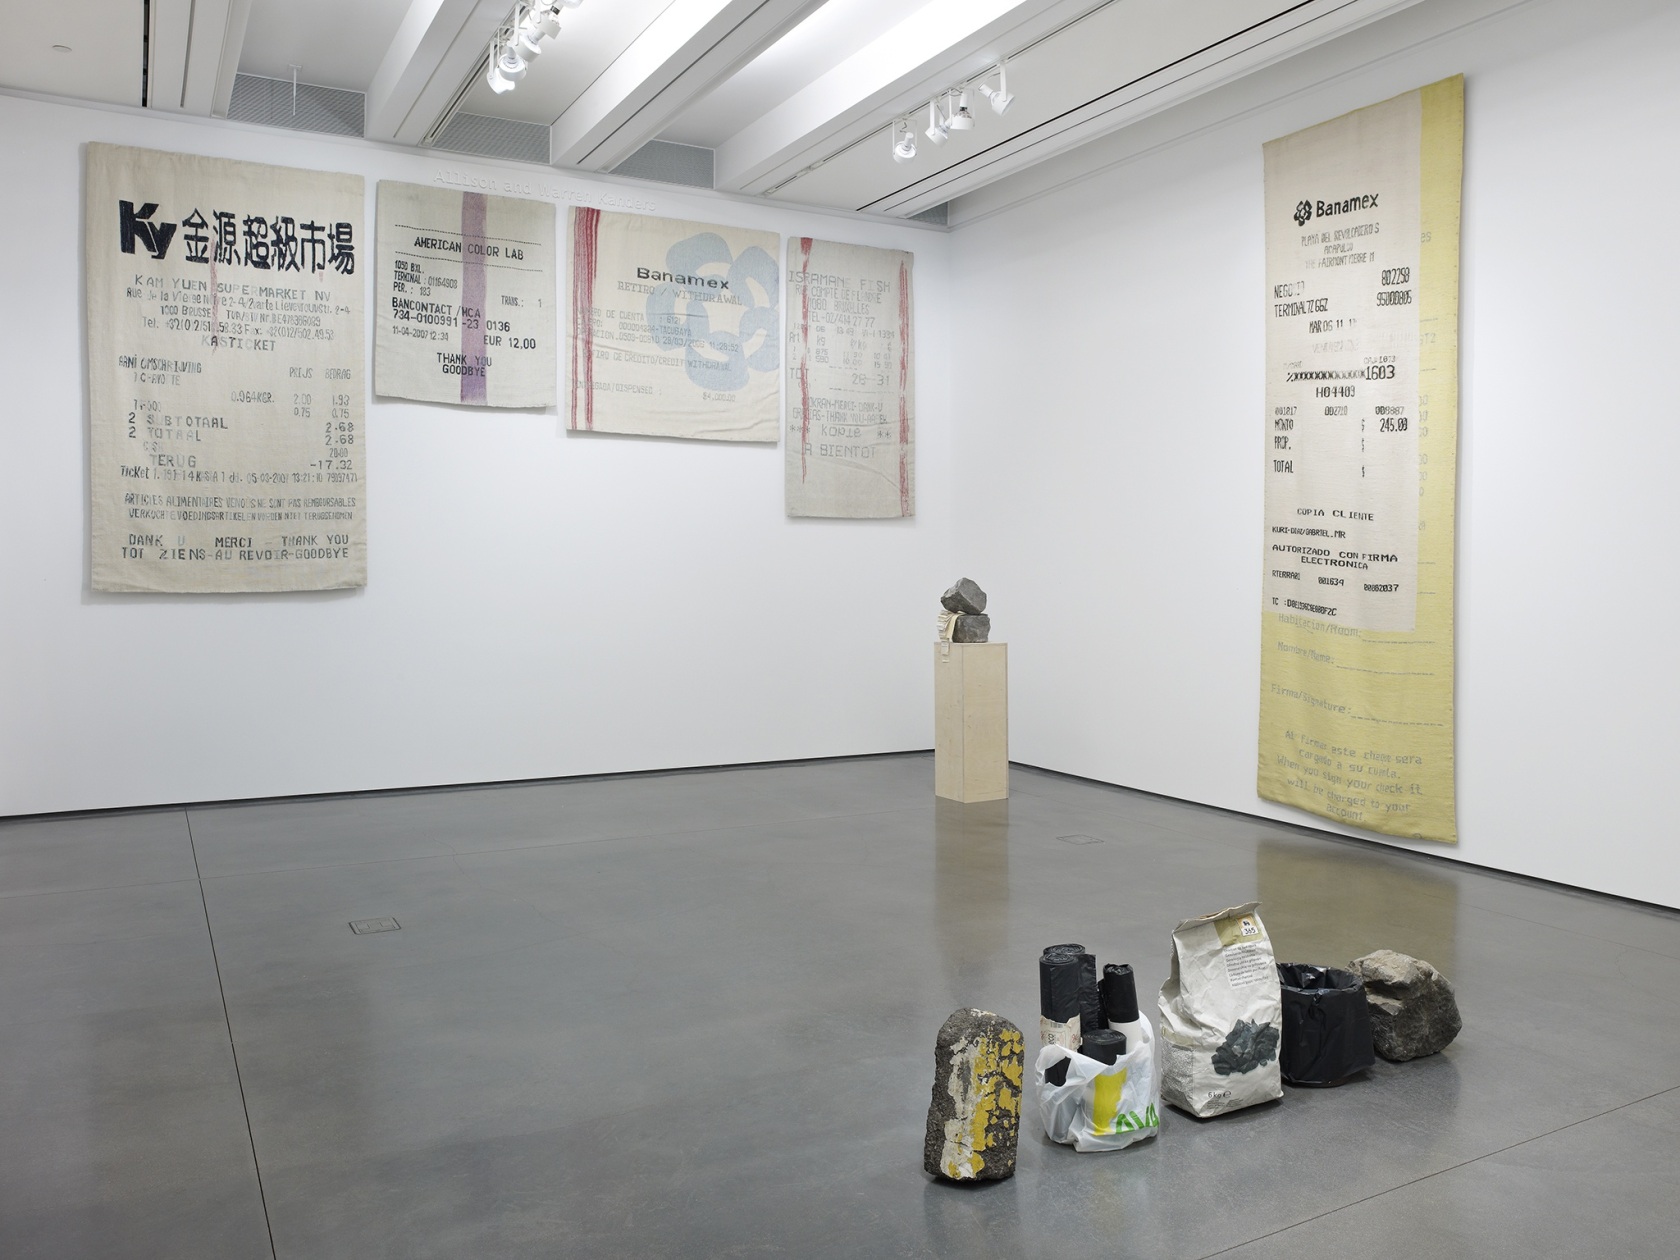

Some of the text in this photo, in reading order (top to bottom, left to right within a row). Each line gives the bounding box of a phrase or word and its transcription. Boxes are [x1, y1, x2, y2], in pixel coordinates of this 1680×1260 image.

[433, 169, 656, 212] Allison and Warren Kanders
[1316, 193, 1379, 218] Banamex
[182, 208, 355, 275] 金源超級市場
[414, 236, 524, 260] AMERICAN COLOR LAB
[637, 267, 729, 290] Banamex
[135, 274, 163, 289] KAM
[172, 278, 207, 291] YUEN
[315, 290, 331, 302] NV
[419, 287, 431, 297] 183
[617, 280, 656, 296] RETIRO
[672, 289, 743, 306] WITHDRAWAL
[1274, 280, 1305, 299] NEGOIO
[391, 296, 453, 316] BANCONTACT
[143, 316, 159, 329] Tel.
[486, 319, 511, 333] 0136
[483, 334, 502, 346] EUR
[437, 352, 492, 367] THANK YOU
[442, 364, 486, 377] GOODBYE
[128, 411, 354, 433] 2 SBTOTAAL 2.68
[128, 426, 136, 439] 2
[325, 434, 354, 446] 2.68
[149, 453, 197, 469] TERUG
[1273, 459, 1294, 474] TOTAL
[1296, 508, 1374, 521] COPIA CLIENTE
[128, 533, 163, 547] DANK
[215, 536, 252, 548] MERCI
[281, 535, 318, 547] THANK
[326, 534, 349, 545] YOU
[122, 546, 144, 559] TOT
[1272, 544, 1398, 563] AUTORIZADO CON FIRMA
[1301, 556, 1369, 570] ELECTRONICA
[1346, 779, 1372, 790] your
